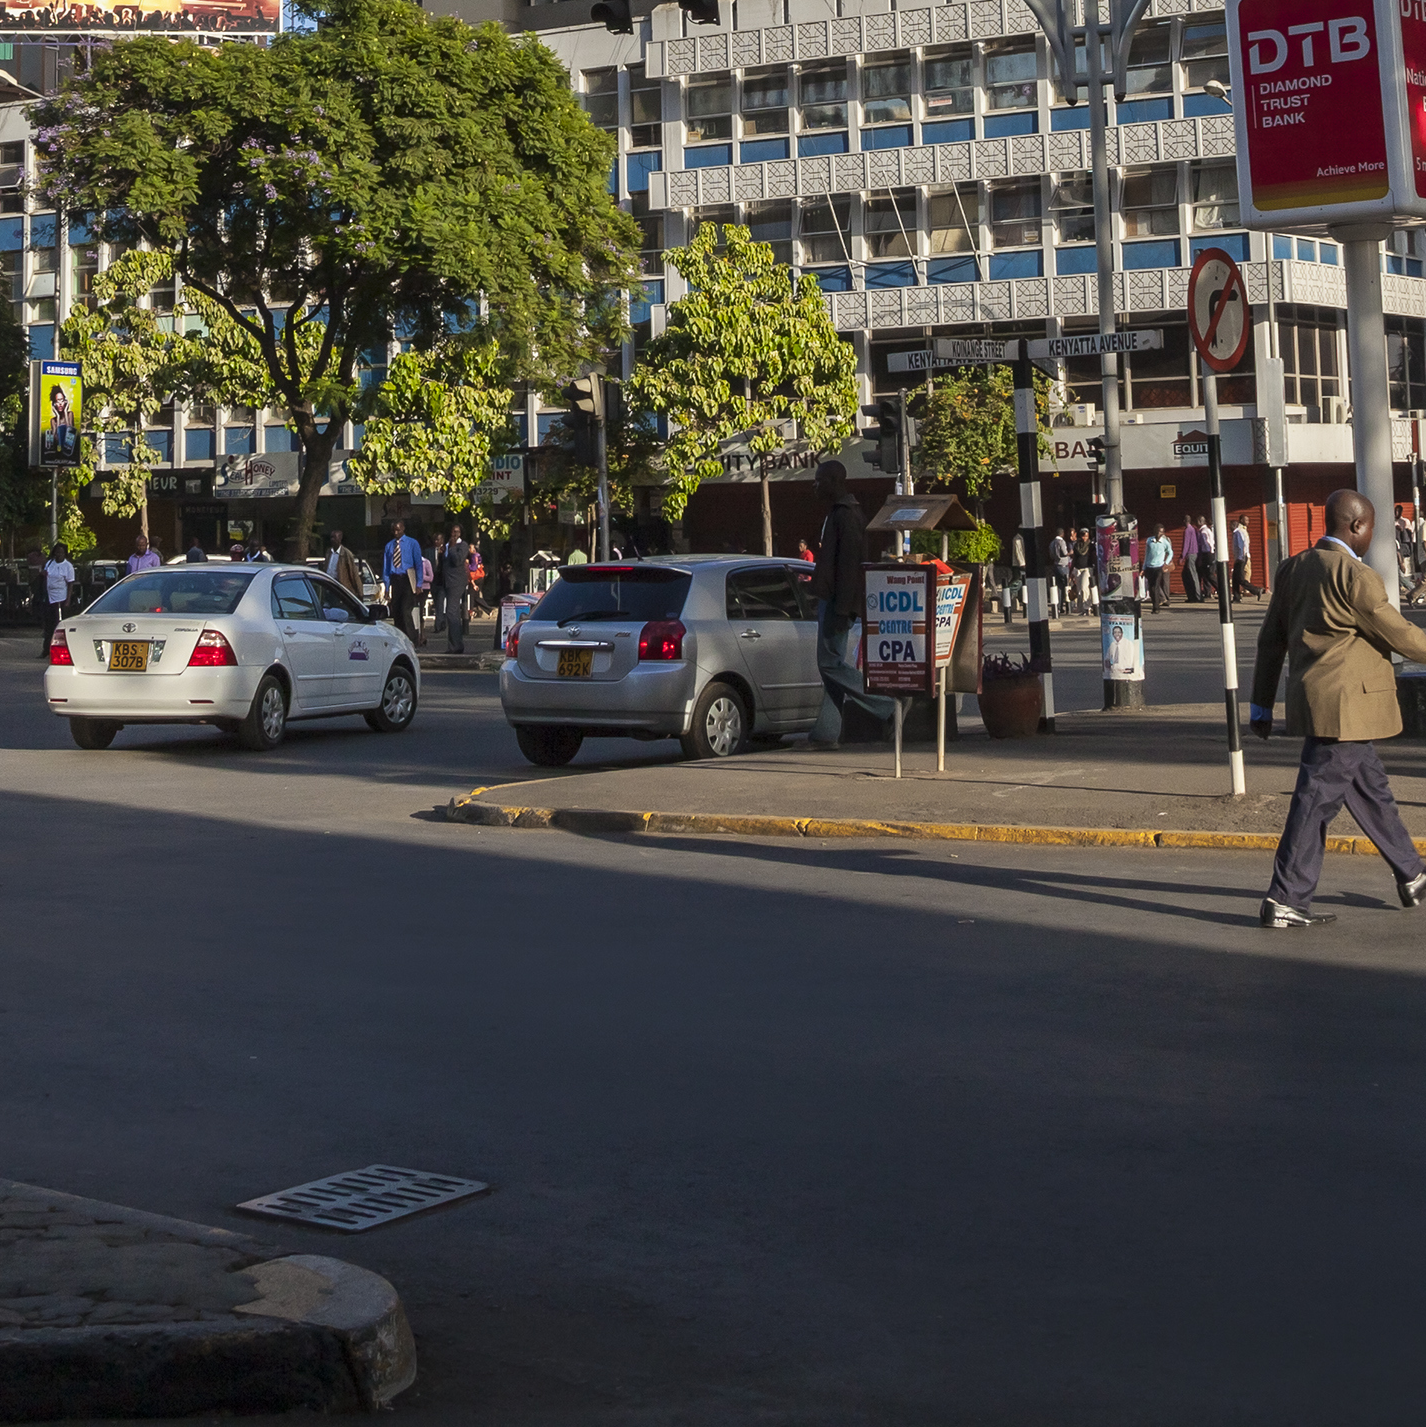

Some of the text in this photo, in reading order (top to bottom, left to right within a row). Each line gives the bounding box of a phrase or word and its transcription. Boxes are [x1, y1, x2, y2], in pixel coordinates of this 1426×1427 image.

[1247, 15, 1371, 75] DTB
[1259, 74, 1333, 95] DIAMOND
[1261, 93, 1311, 112] TRUST
[1262, 111, 1306, 128] BANK
[1316, 160, 1385, 177] Achieve More
[1416, 156, 1421, 171] 5
[951, 340, 1006, 358] KOINANGE STREET
[1049, 332, 1138, 357] KENYATTA AVENUE
[46, 365, 77, 375] SAMSUNG
[1174, 443, 1209, 454] EQUIT
[887, 575, 925, 585] Wang Point
[942, 587, 963, 600] ICDL
[879, 591, 924, 612] ICDL
[879, 620, 912, 634] CENTRE
[114, 643, 137, 655] KBS
[559, 649, 582, 662] KBK
[879, 640, 916, 661] CPA
[112, 656, 143, 668] 307B
[558, 662, 590, 676] 692K
